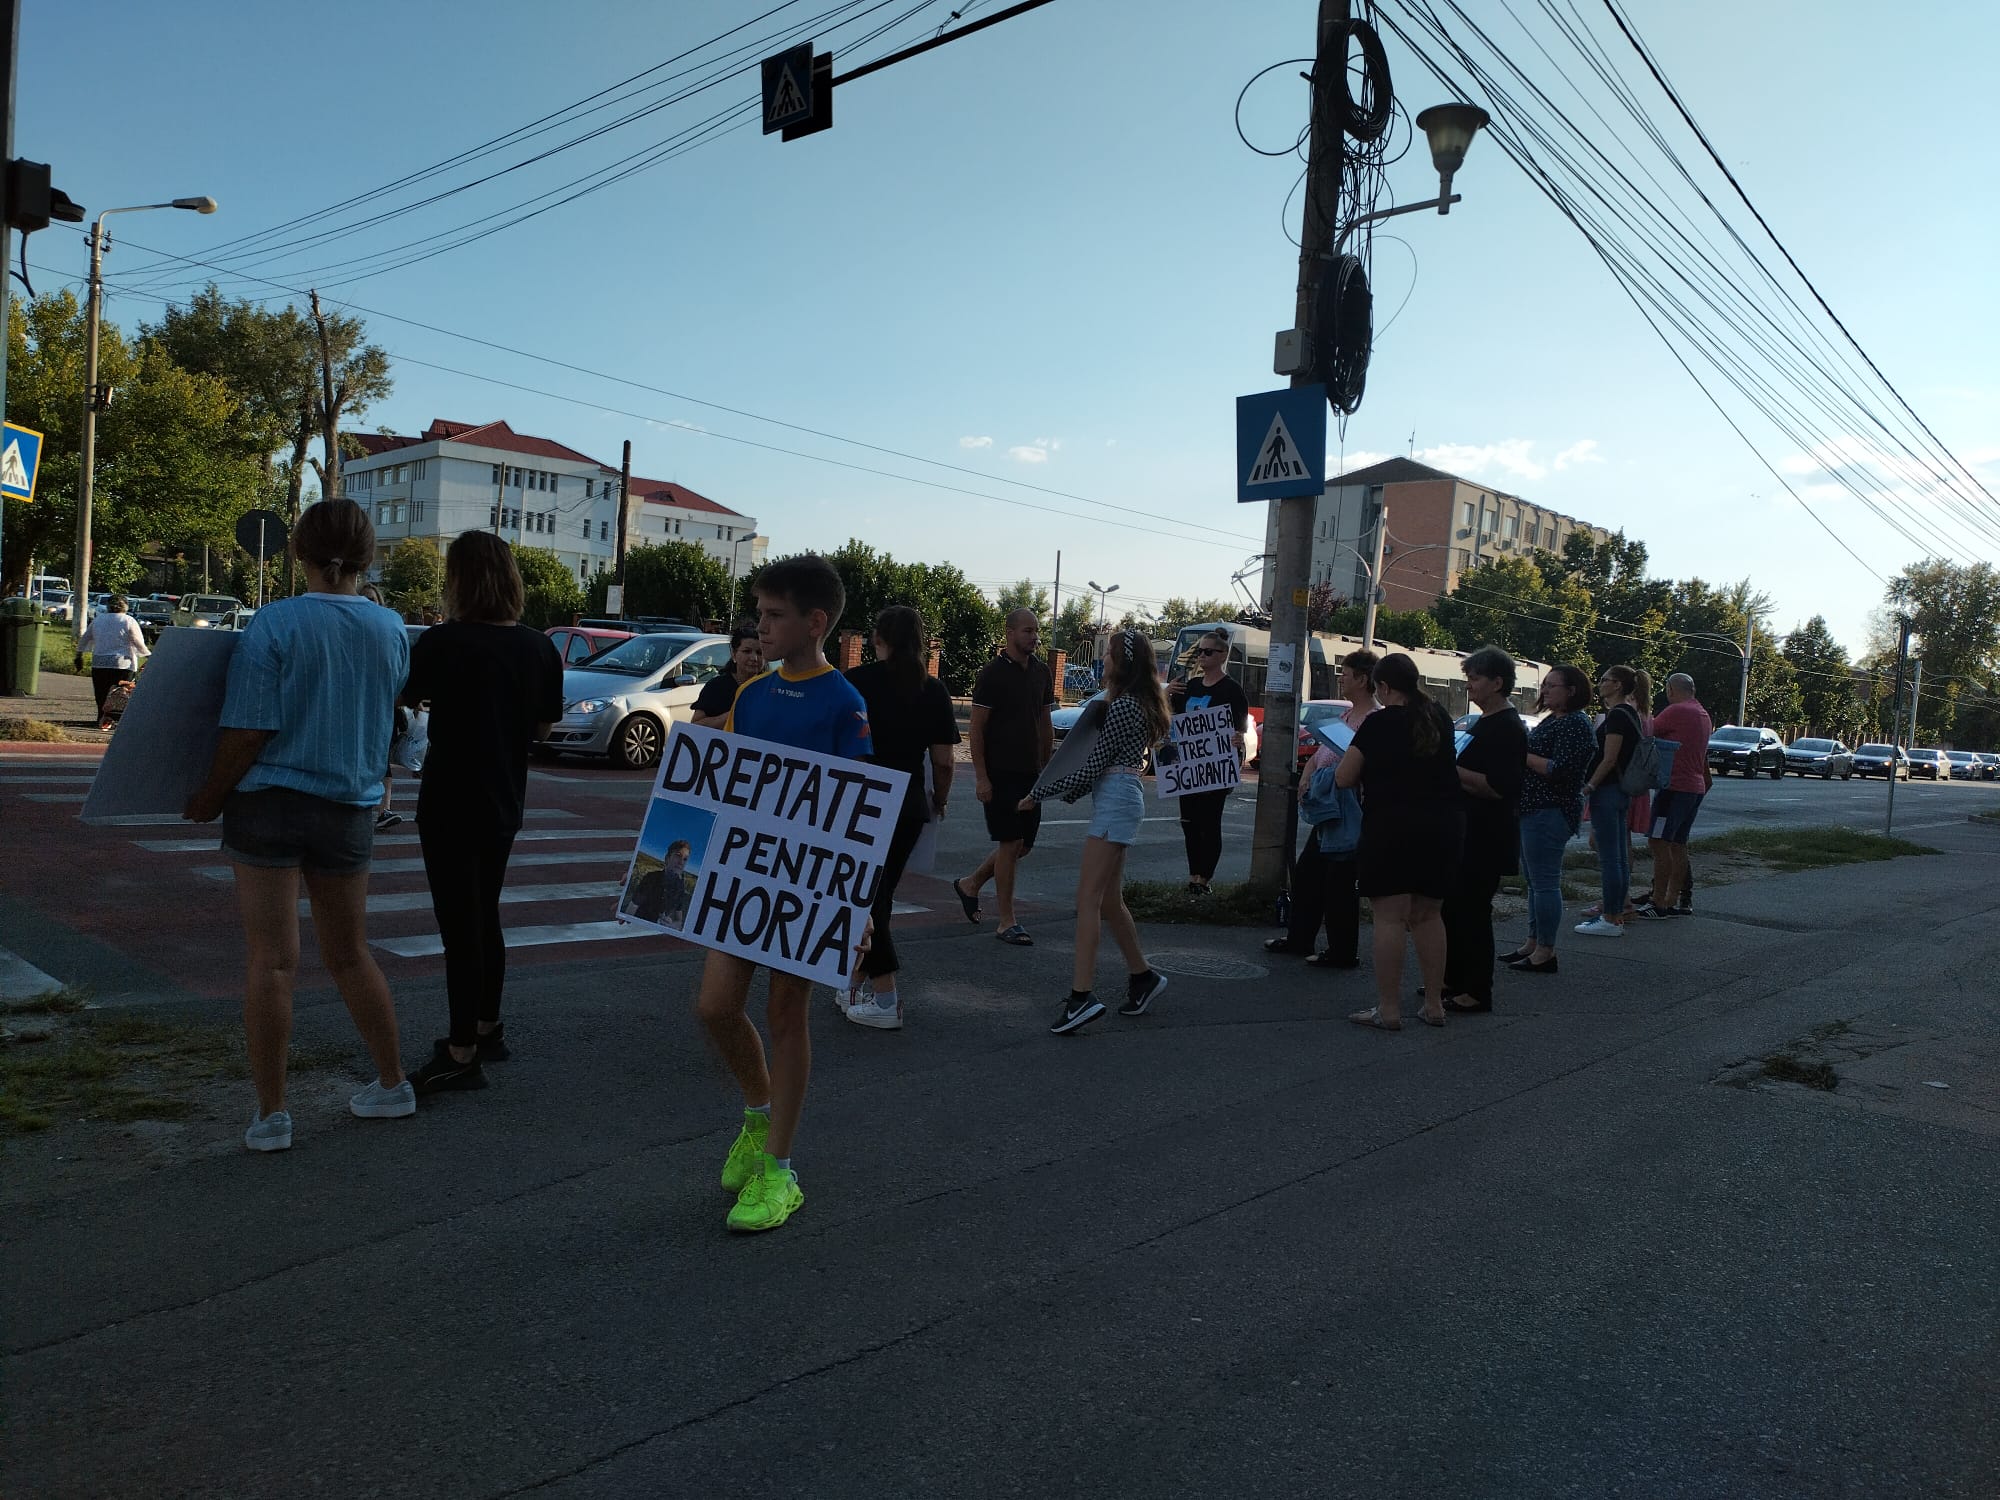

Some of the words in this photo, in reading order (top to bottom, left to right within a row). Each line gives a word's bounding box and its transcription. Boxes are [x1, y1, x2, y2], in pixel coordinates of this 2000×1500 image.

[1175, 713, 1217, 737] VREAU
[1217, 705, 1234, 729] SĂ
[1179, 738, 1213, 760] TREC
[1215, 731, 1231, 755] ÎN
[662, 732, 893, 846] DREPTATE
[719, 826, 883, 908] PENTRU
